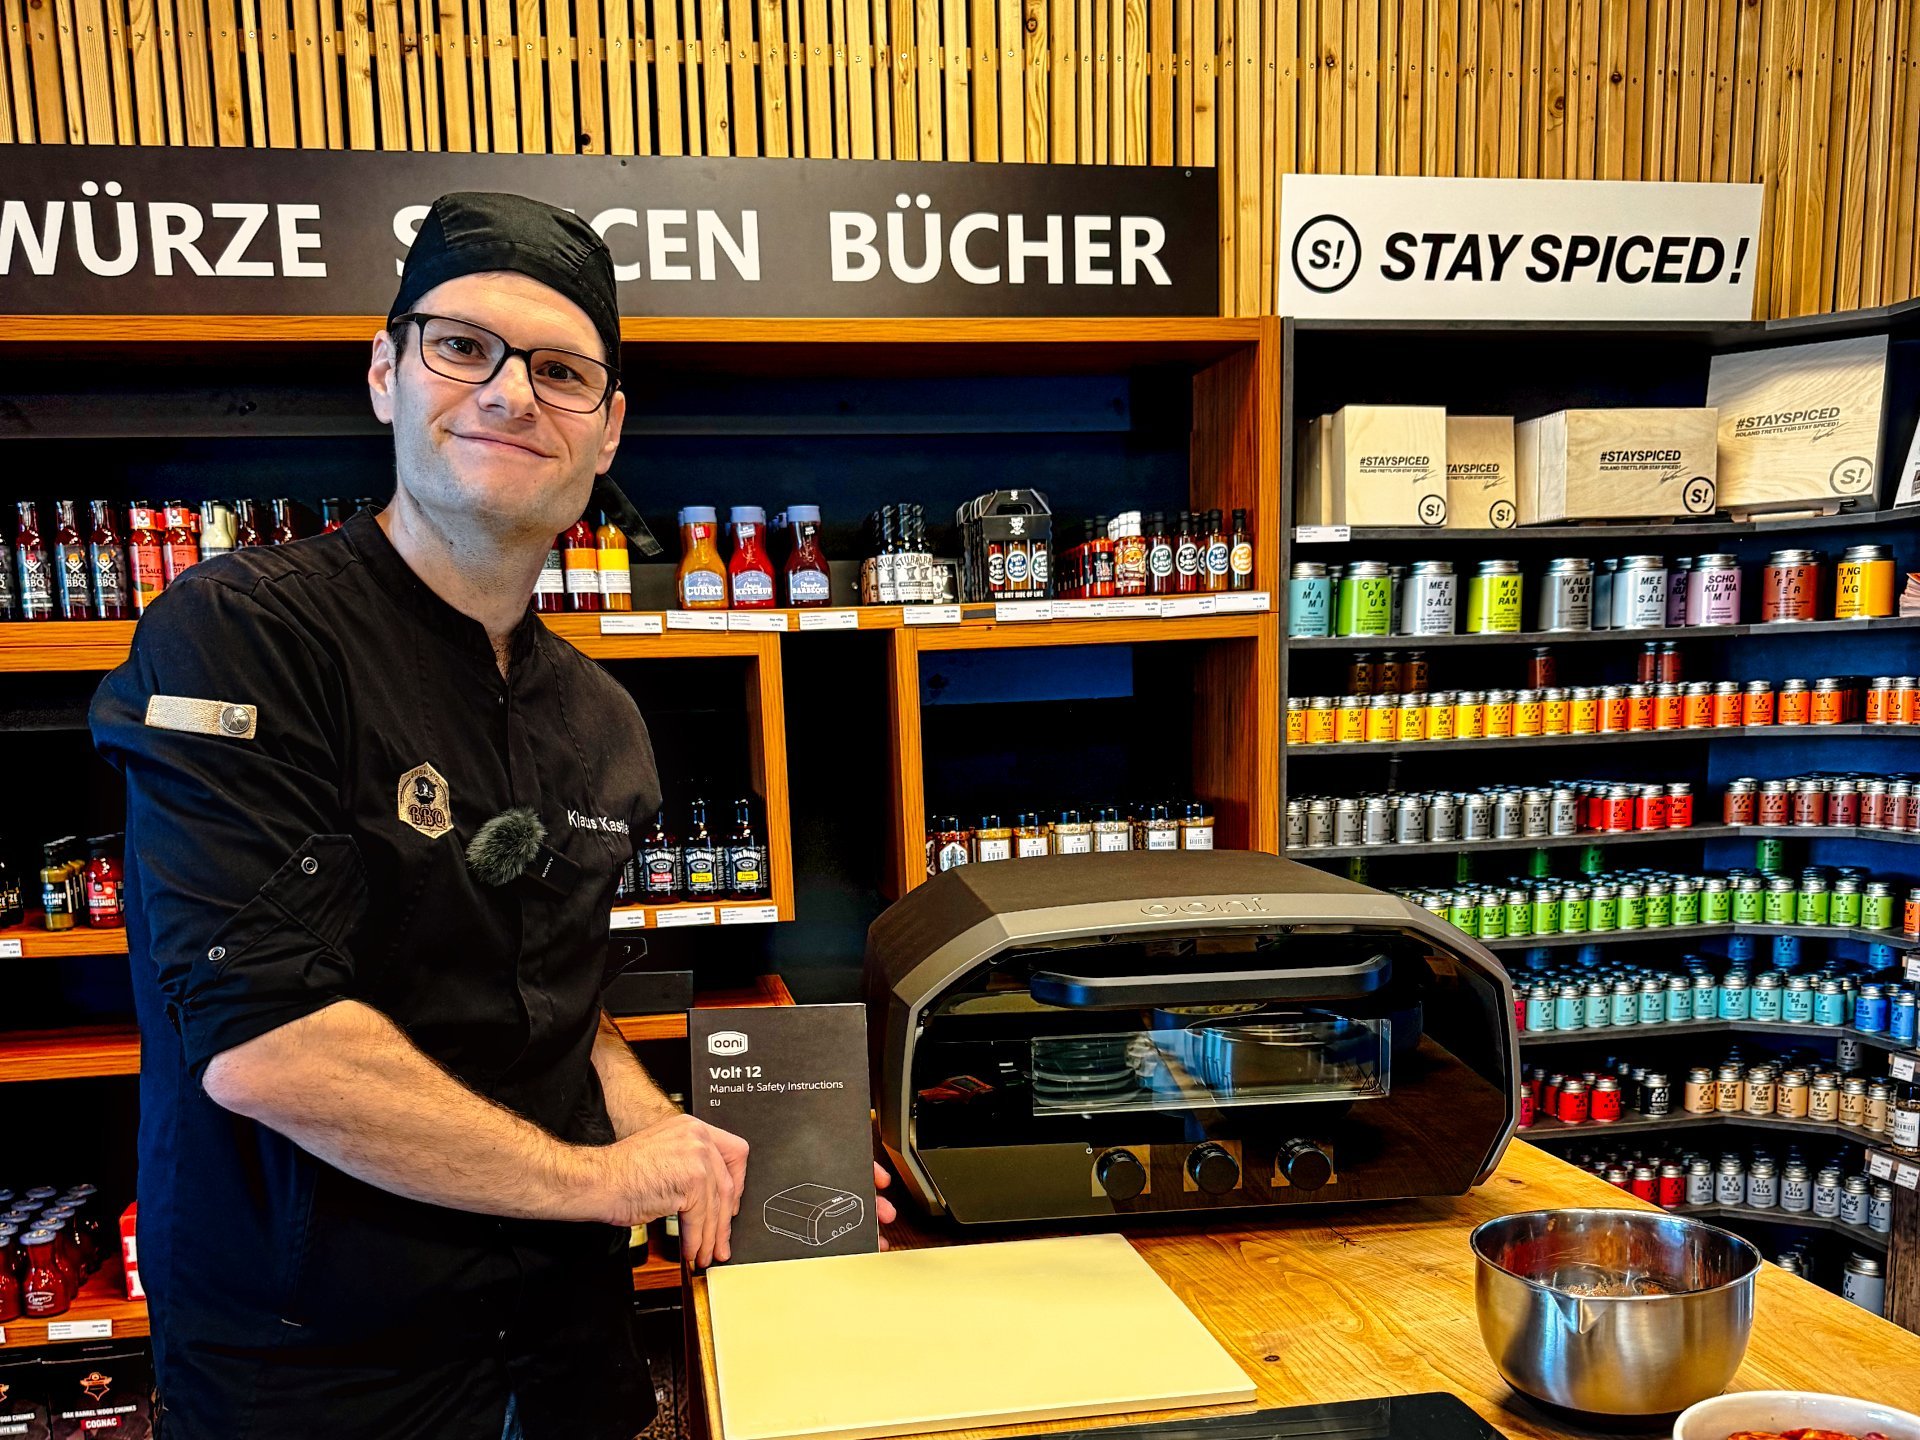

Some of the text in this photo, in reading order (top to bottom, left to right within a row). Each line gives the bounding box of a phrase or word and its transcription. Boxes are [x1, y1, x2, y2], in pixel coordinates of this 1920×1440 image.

[829, 192, 1172, 285] BÜCHER
[1380, 232, 1523, 282] STAY
[1736, 407, 1840, 429] #STAYSPICED
[1360, 456, 1430, 466] #STAYSPICED
[1600, 450, 1681, 462] #STAYSPICED
[1446, 463, 1500, 473] TAYSPICED
[1840, 467, 1865, 485] S!
[1690, 488, 1709, 503] S!
[1425, 504, 1441, 517] S!
[1496, 509, 1511, 522] S!
[1708, 574, 1735, 584] SCHO
[686, 586, 723, 596] CURRY
[408, 804, 448, 830] BBQ
[568, 810, 597, 830] Klaus
[714, 1037, 743, 1048] ooni
[709, 1066, 762, 1080] Volt 12
[709, 1080, 844, 1093] Manual & Safety Instructions
[710, 1099, 721, 1107] EU
[12, 1412, 35, 1421] CHUNKS
[97, 1408, 114, 1416] WOOD
[114, 1405, 137, 1413] CHUNKS
[12, 1424, 27, 1432] WINE
[85, 1417, 118, 1429] COGNAC
